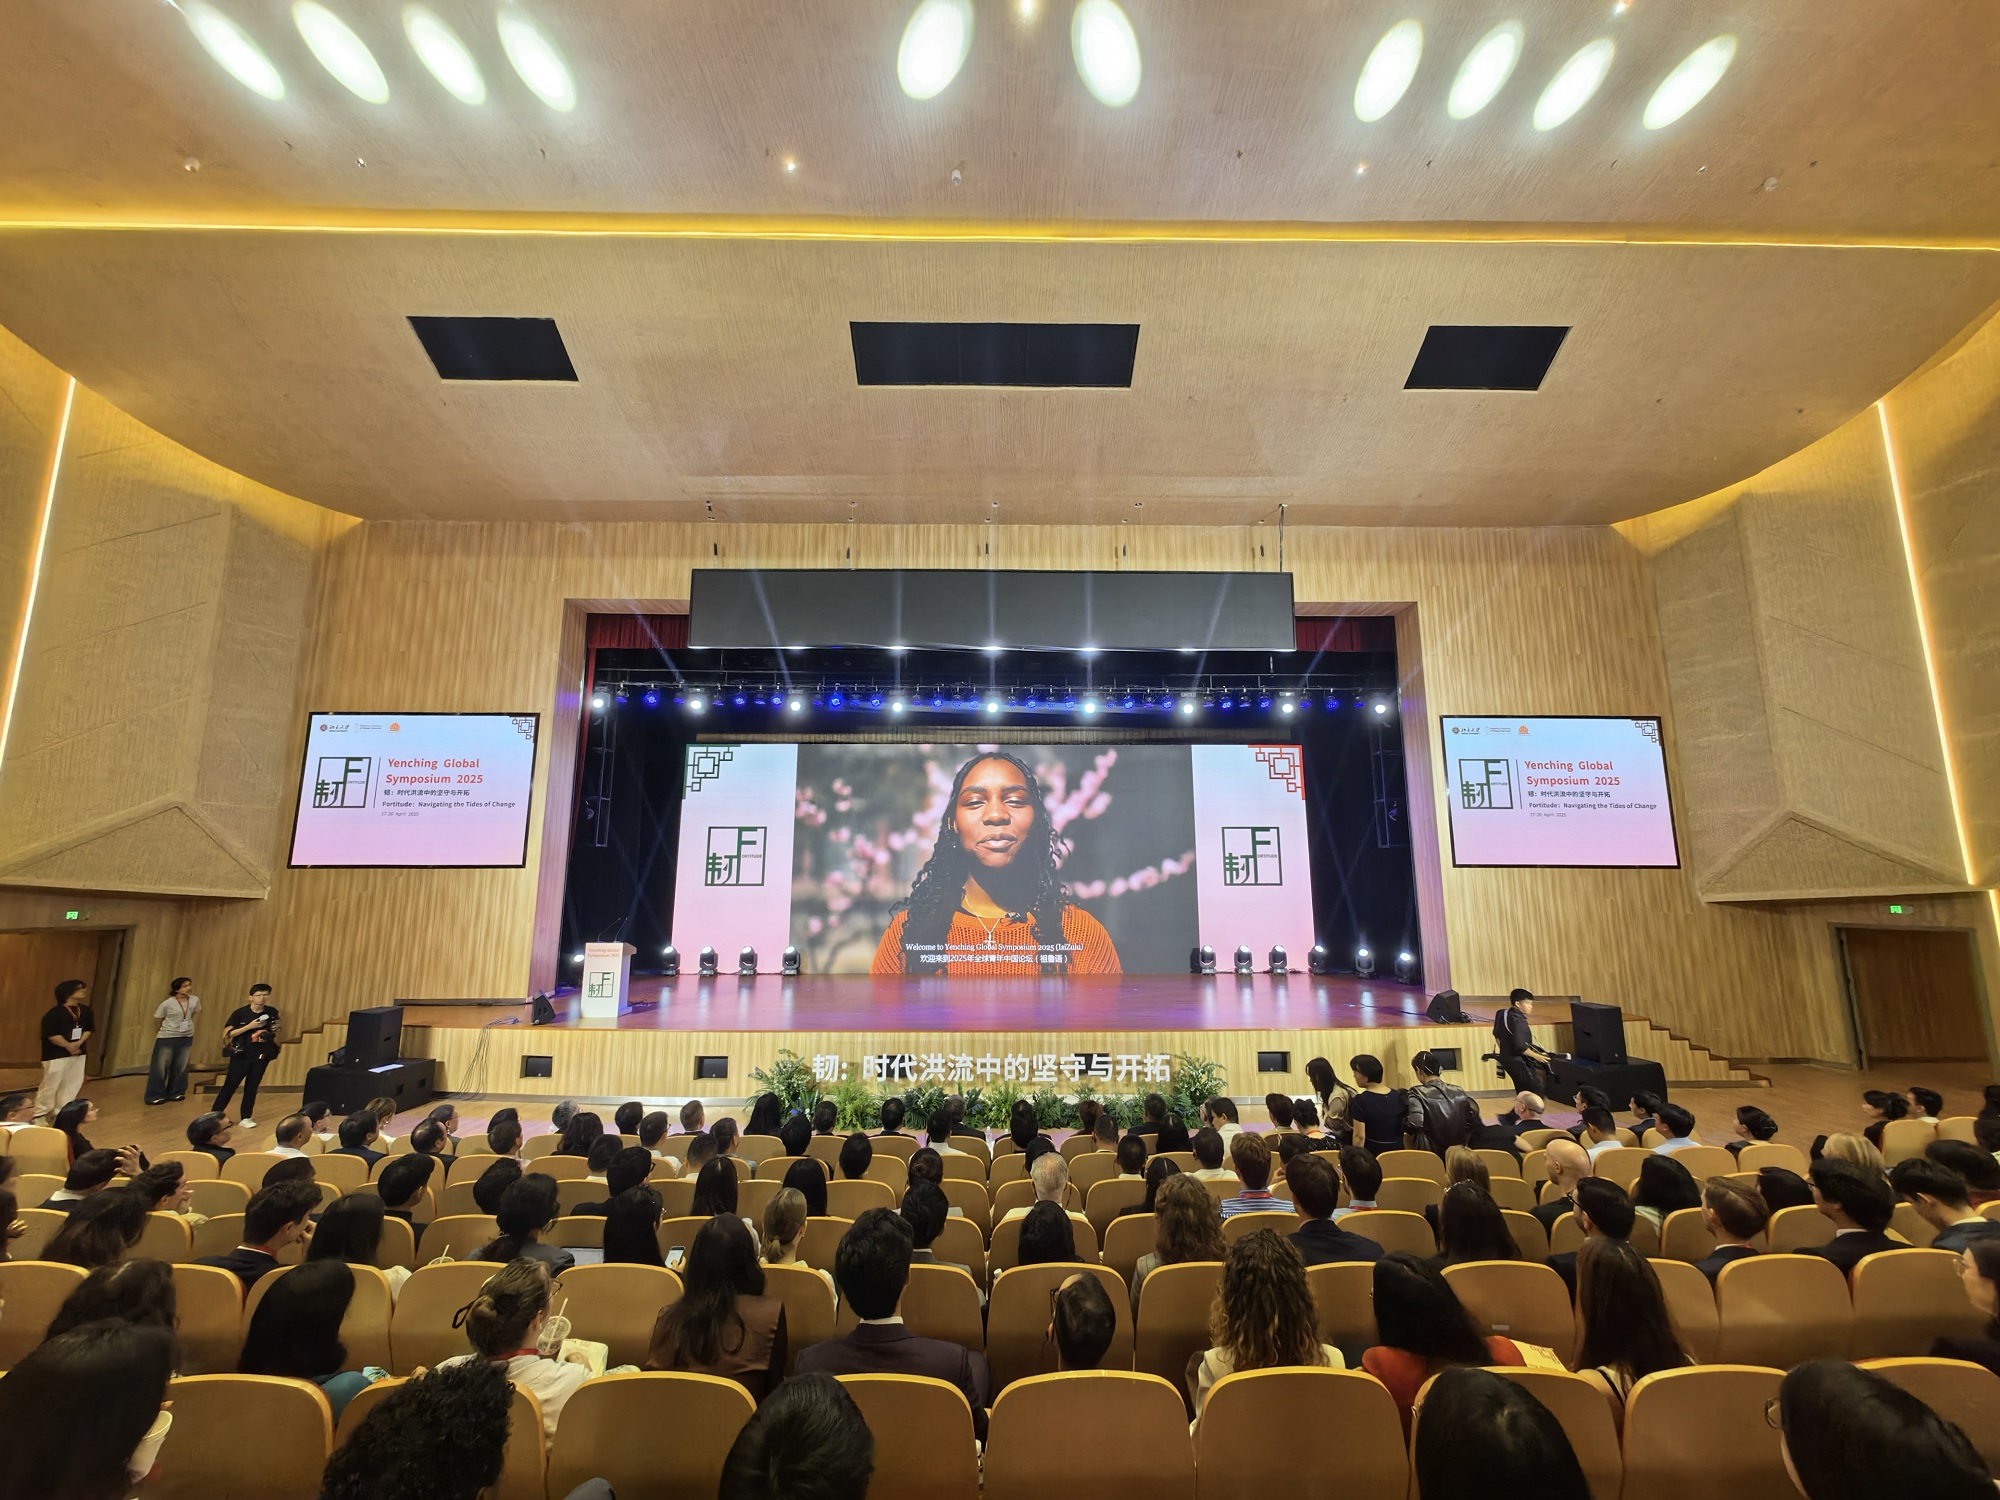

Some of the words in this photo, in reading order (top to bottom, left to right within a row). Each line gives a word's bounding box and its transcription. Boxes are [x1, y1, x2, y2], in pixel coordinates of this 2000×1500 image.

[388, 758, 438, 770] Yenching
[443, 758, 480, 768] Global
[1524, 761, 1573, 772] Yenching
[1578, 761, 1613, 770] Global
[385, 774, 451, 785] Symposium
[457, 774, 483, 784] 2025
[1526, 776, 1589, 787] Symposium
[1595, 776, 1620, 786] 2025
[905, 943, 936, 951] Welcome
[937, 943, 944, 951] to
[945, 943, 975, 952] Yenching
[998, 943, 1036, 952] Symposium
[1037, 944, 1055, 952] 2025
